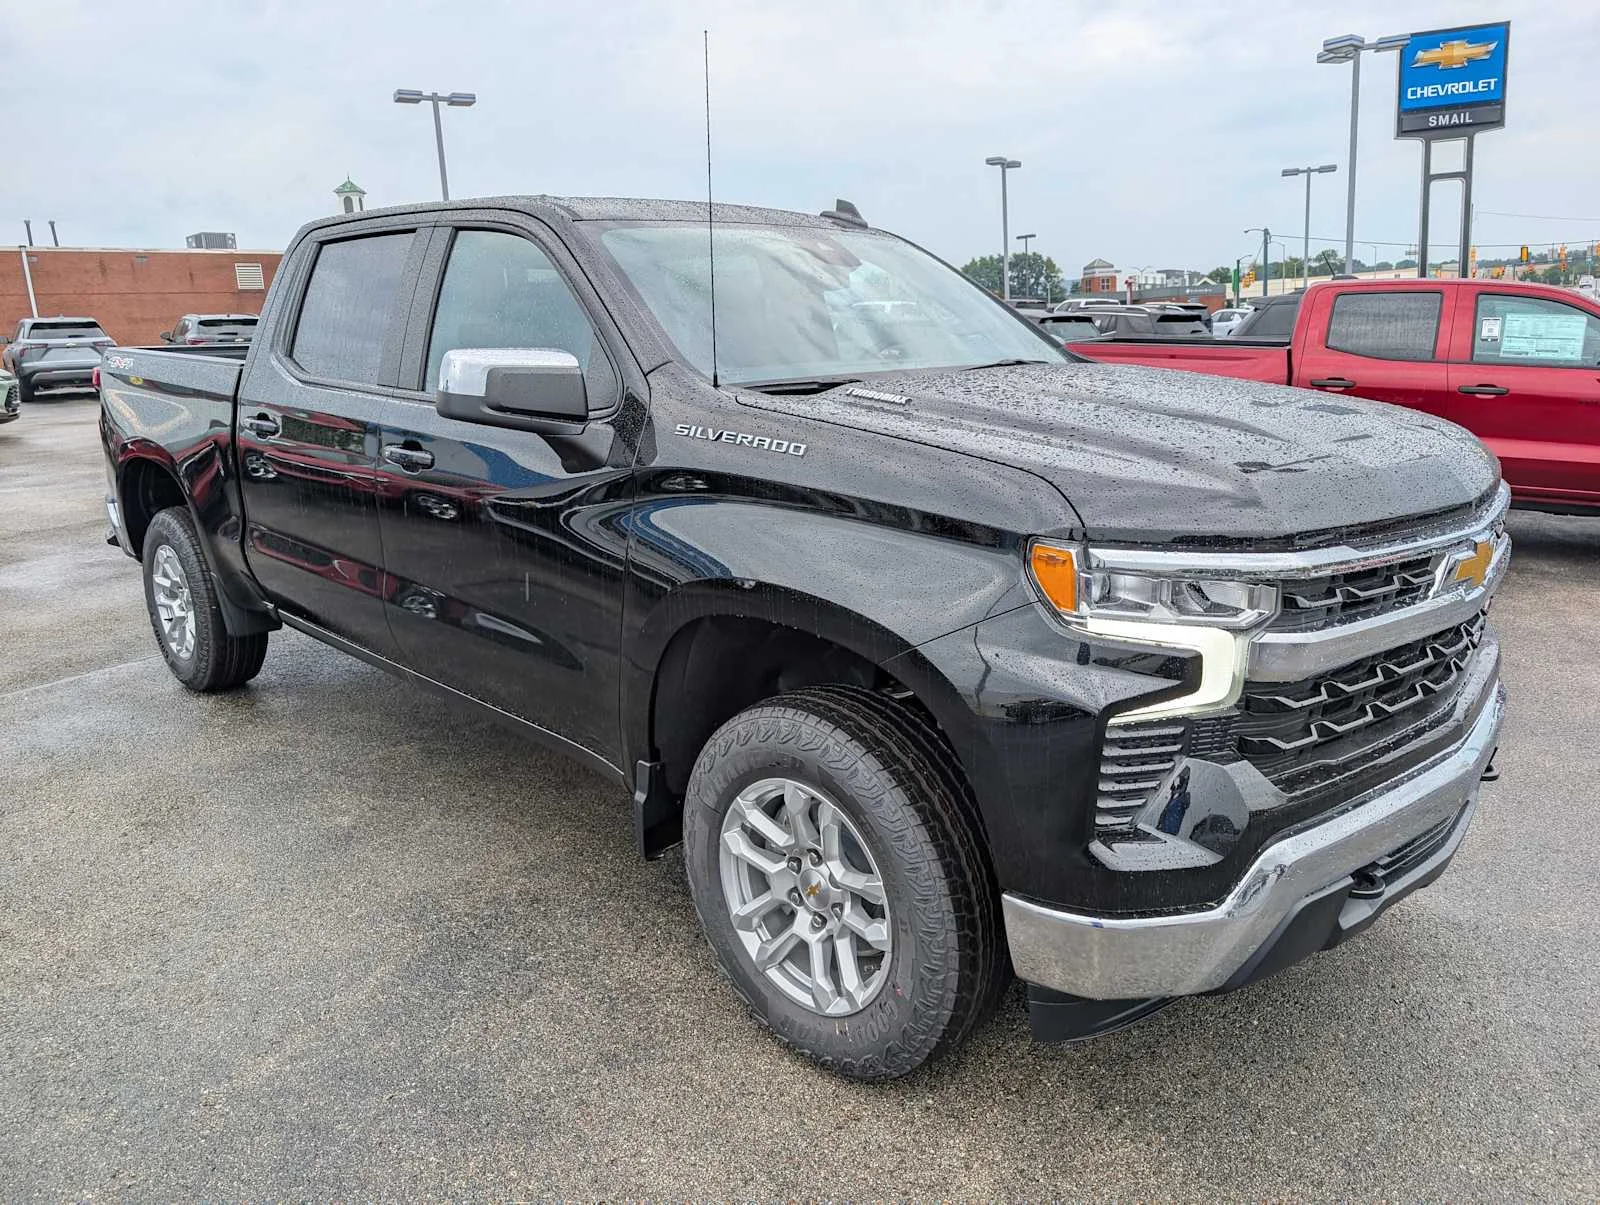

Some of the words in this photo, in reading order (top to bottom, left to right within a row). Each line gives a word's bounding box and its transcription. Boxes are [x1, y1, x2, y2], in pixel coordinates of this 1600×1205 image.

[1407, 78, 1498, 99] CHEVROLET
[1428, 112, 1473, 127] SMAIL
[674, 423, 807, 456] SILVERADO
